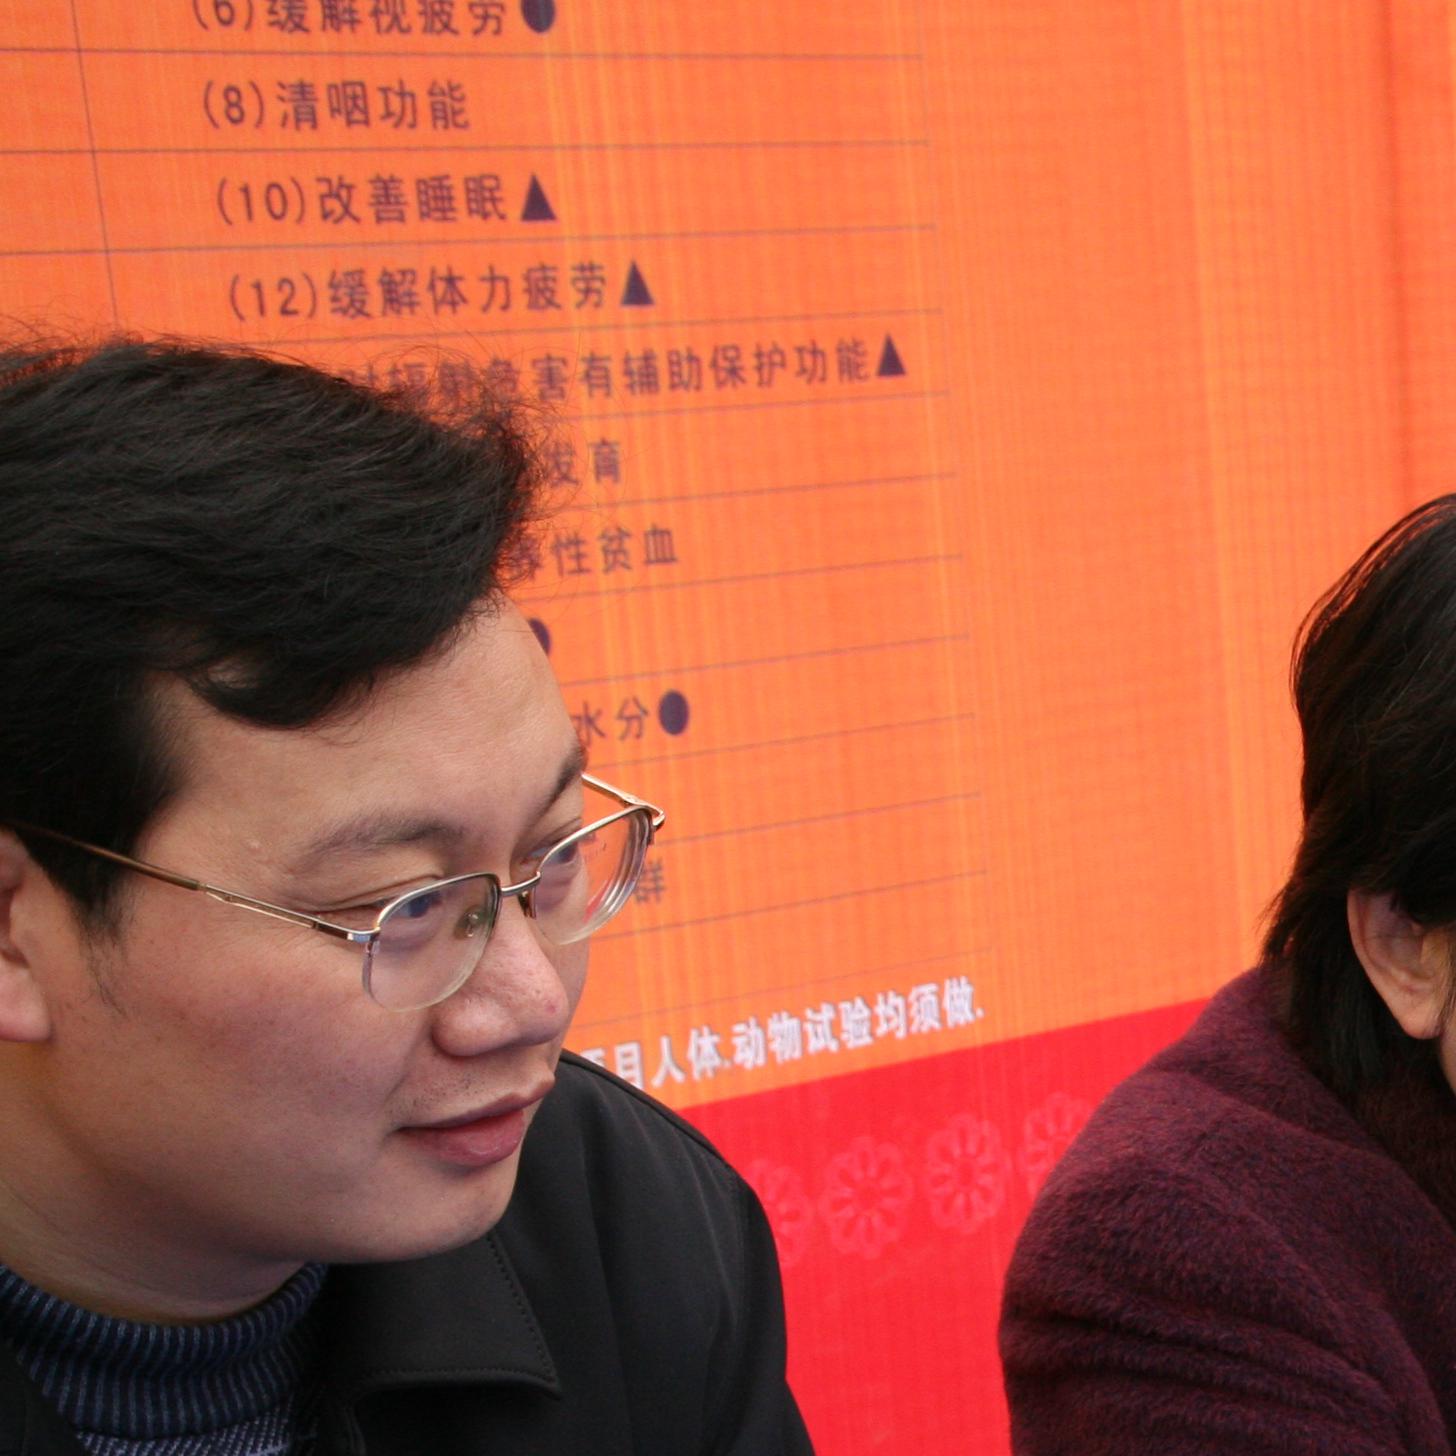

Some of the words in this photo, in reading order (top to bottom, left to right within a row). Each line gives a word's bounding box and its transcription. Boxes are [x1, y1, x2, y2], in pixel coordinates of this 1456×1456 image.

[203, 79, 470, 130] (8)清咽功能
[216, 173, 508, 225] (10)改善睡眠
[229, 262, 608, 321] (12)缓解体力疲劳
